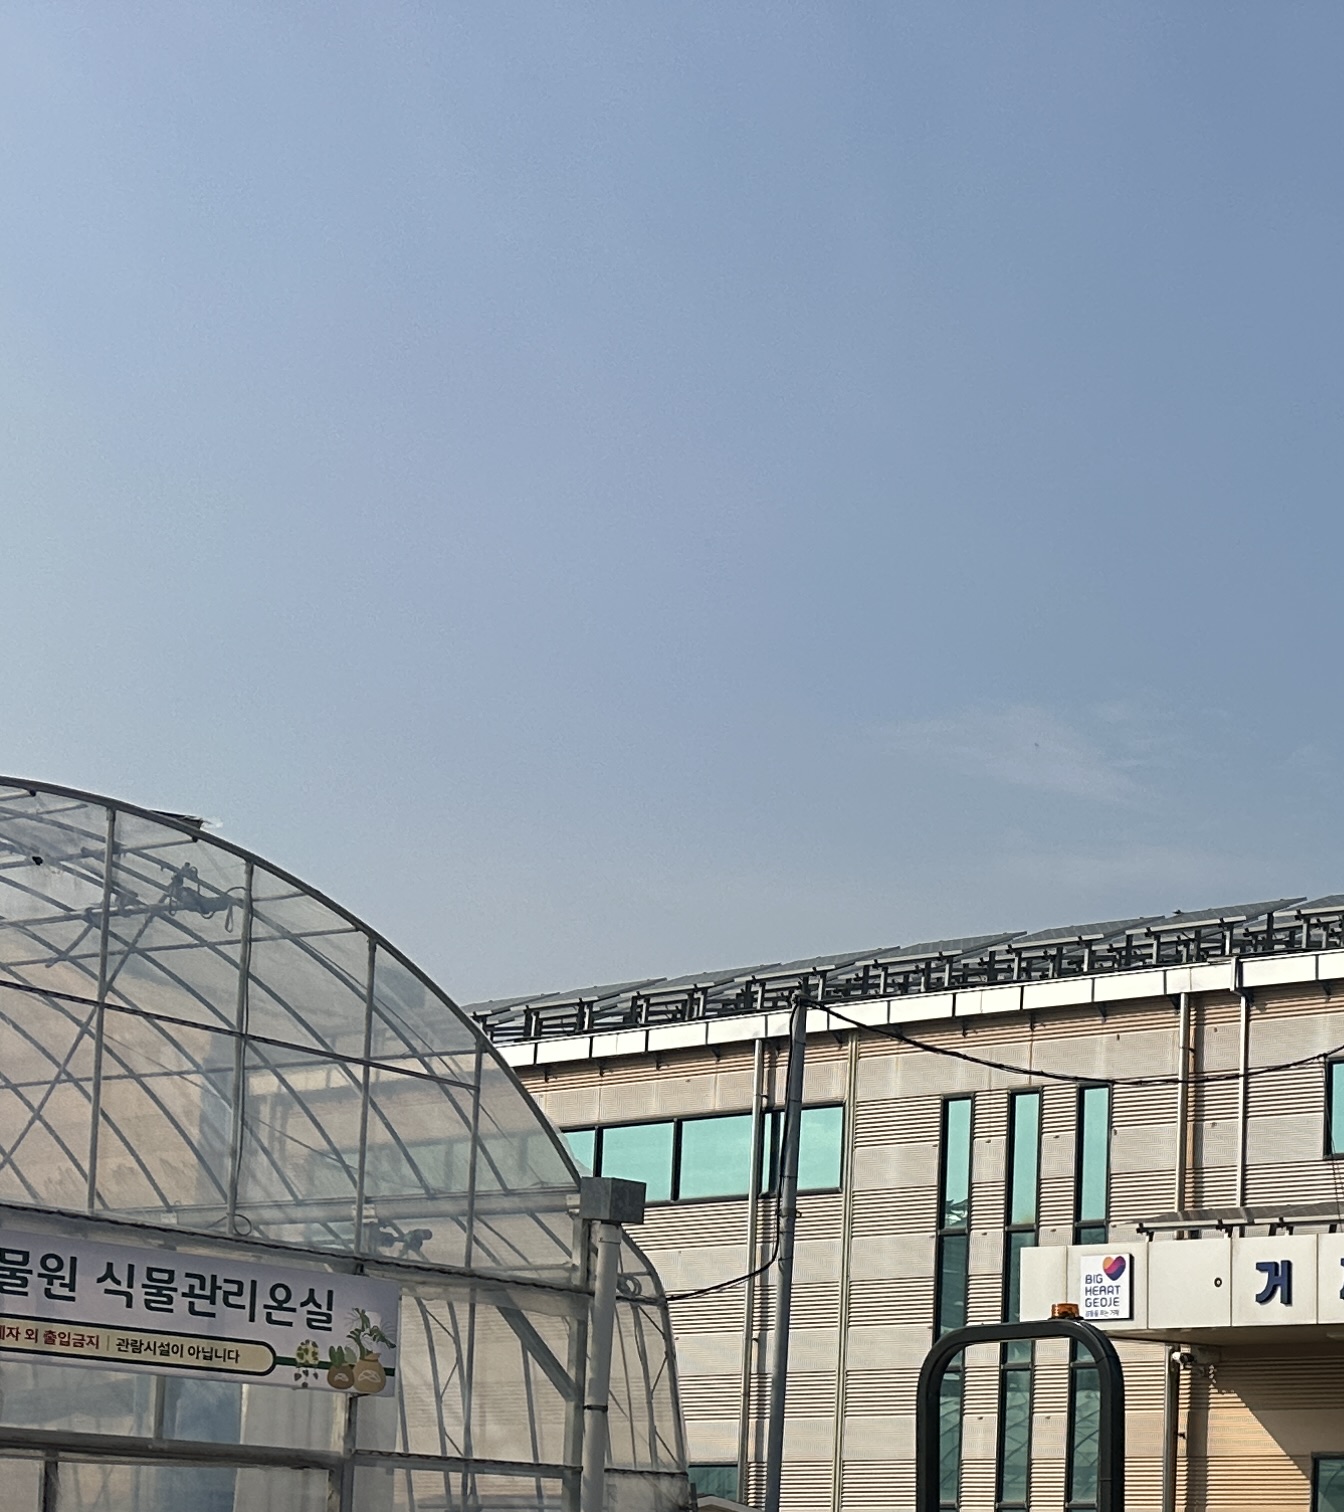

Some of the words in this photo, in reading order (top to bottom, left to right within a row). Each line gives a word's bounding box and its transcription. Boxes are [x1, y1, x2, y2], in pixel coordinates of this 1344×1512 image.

[1085, 1273, 1103, 1284] BIG
[0, 1247, 78, 1302] 물원
[96, 1260, 335, 1332] 식물관리온실
[1085, 1285, 1121, 1296] HEART
[1085, 1297, 1120, 1307] GEOJE
[24, 1328, 39, 1344] 외
[43, 1330, 100, 1350] 출입금지
[115, 1337, 184, 1359] 관람시설이
[187, 1345, 241, 1364] 아닙니다
